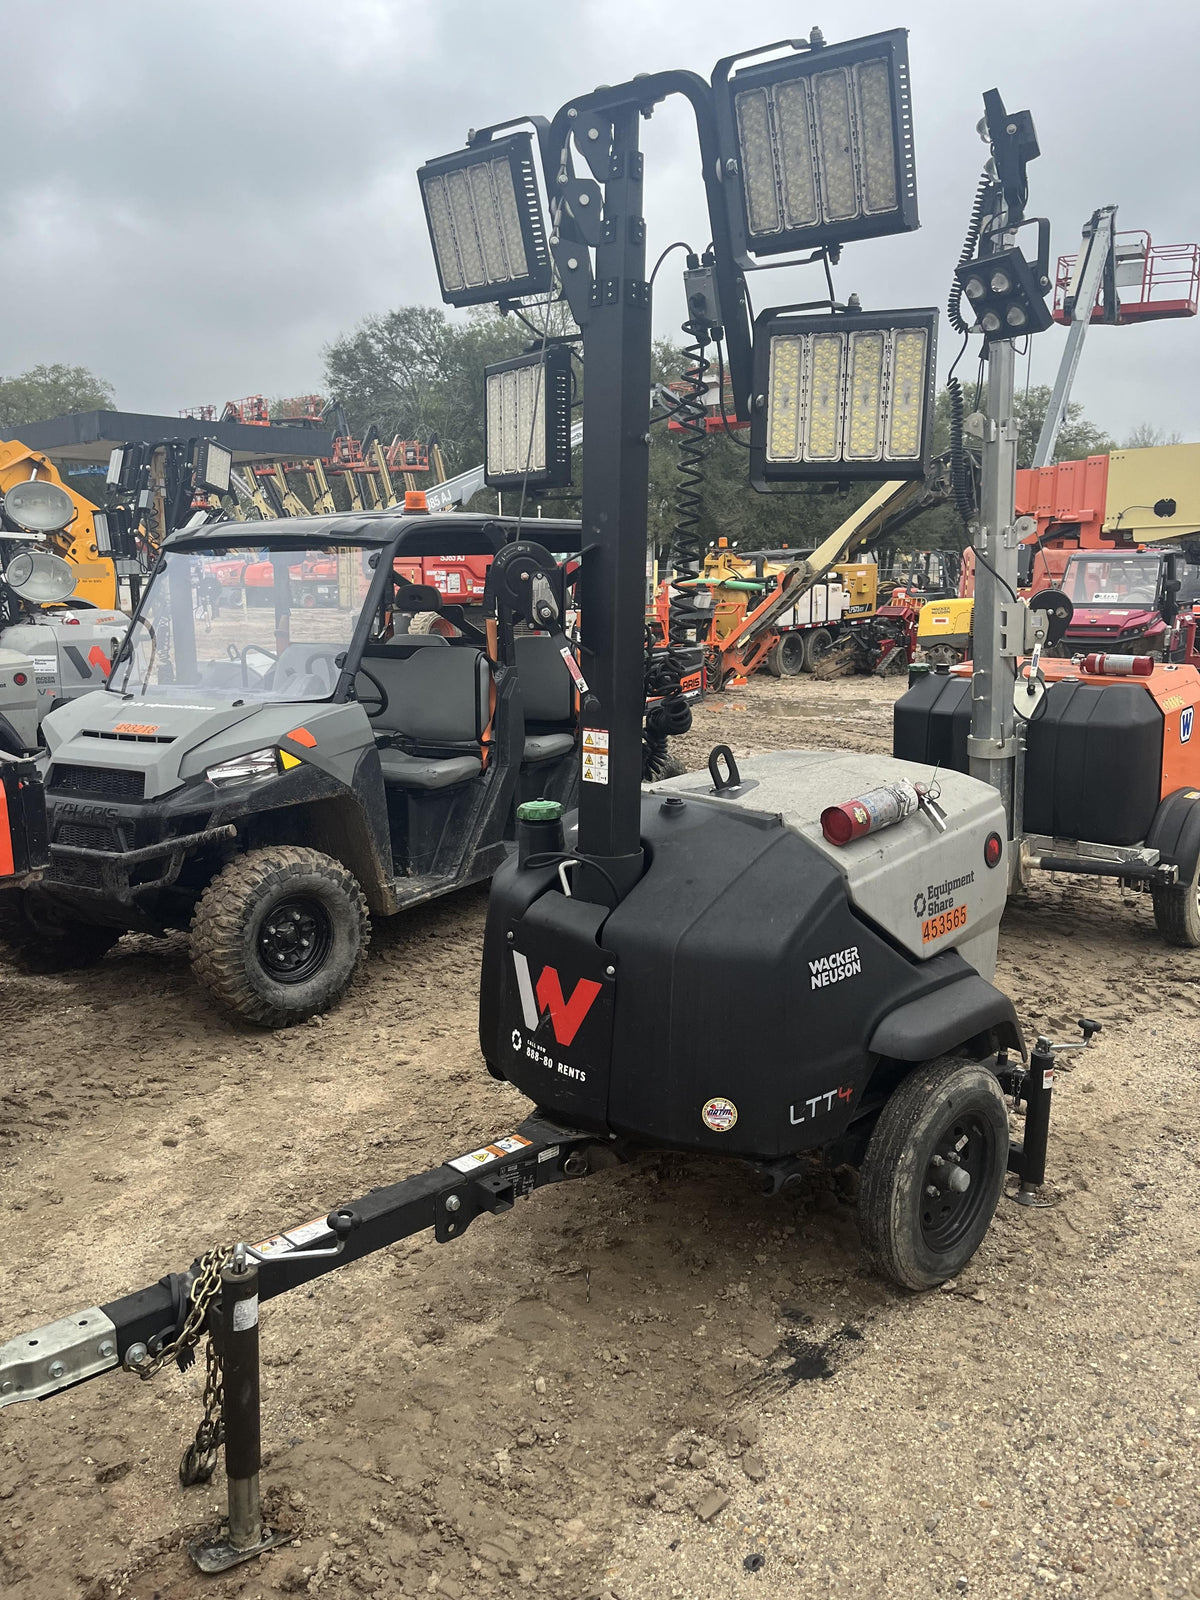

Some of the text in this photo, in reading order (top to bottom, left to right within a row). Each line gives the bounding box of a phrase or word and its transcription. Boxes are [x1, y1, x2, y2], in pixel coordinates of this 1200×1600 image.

[426, 489, 452, 511] J85 AJ
[115, 723, 158, 734] 493218
[927, 870, 975, 900] Equipment
[927, 897, 954, 917] Share
[923, 905, 967, 941] 453565
[808, 946, 860, 975] WACKER
[810, 959, 862, 990] NEUSON
[526, 1046, 586, 1082] 888-80 RENTS
[789, 1087, 853, 1125] LTT4
